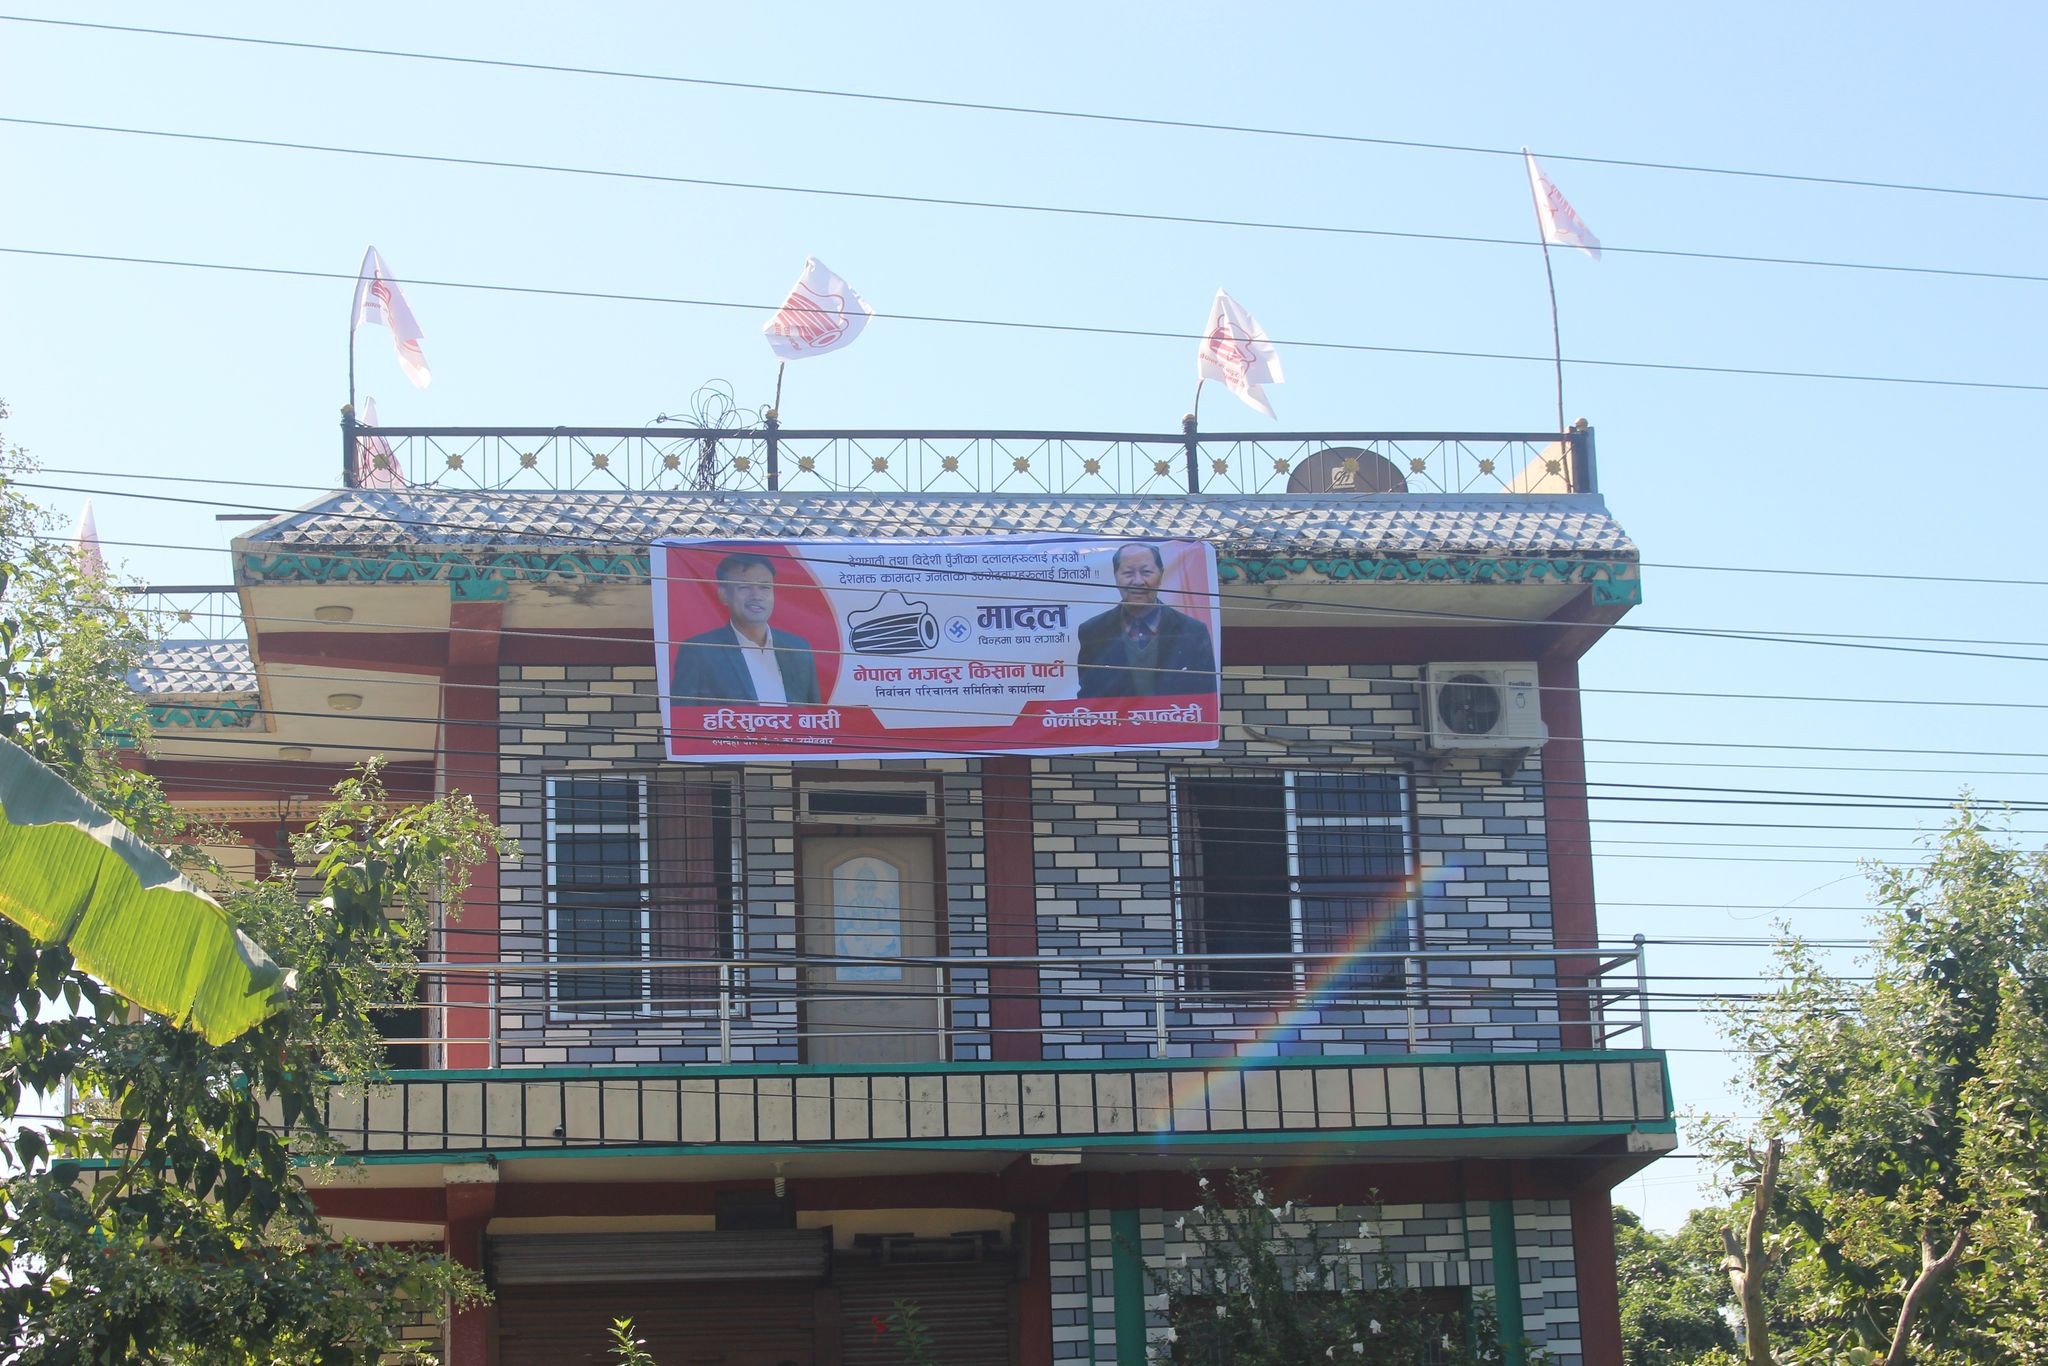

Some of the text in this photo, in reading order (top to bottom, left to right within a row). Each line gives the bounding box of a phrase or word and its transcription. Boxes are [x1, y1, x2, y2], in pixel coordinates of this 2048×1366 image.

[888, 556, 908, 566] तथा
[911, 553, 942, 566] विदेशी
[880, 573, 922, 584] कामदार
[977, 605, 1069, 630] मादल
[1015, 635, 1031, 644] छाप
[853, 660, 1065, 683] नेपाल मजदुर किसान पार्टी
[875, 682, 1045, 697] निर्वाचन परिचालन समितिको कार्यालय
[703, 708, 841, 732] हरिसुन्दर बासी
